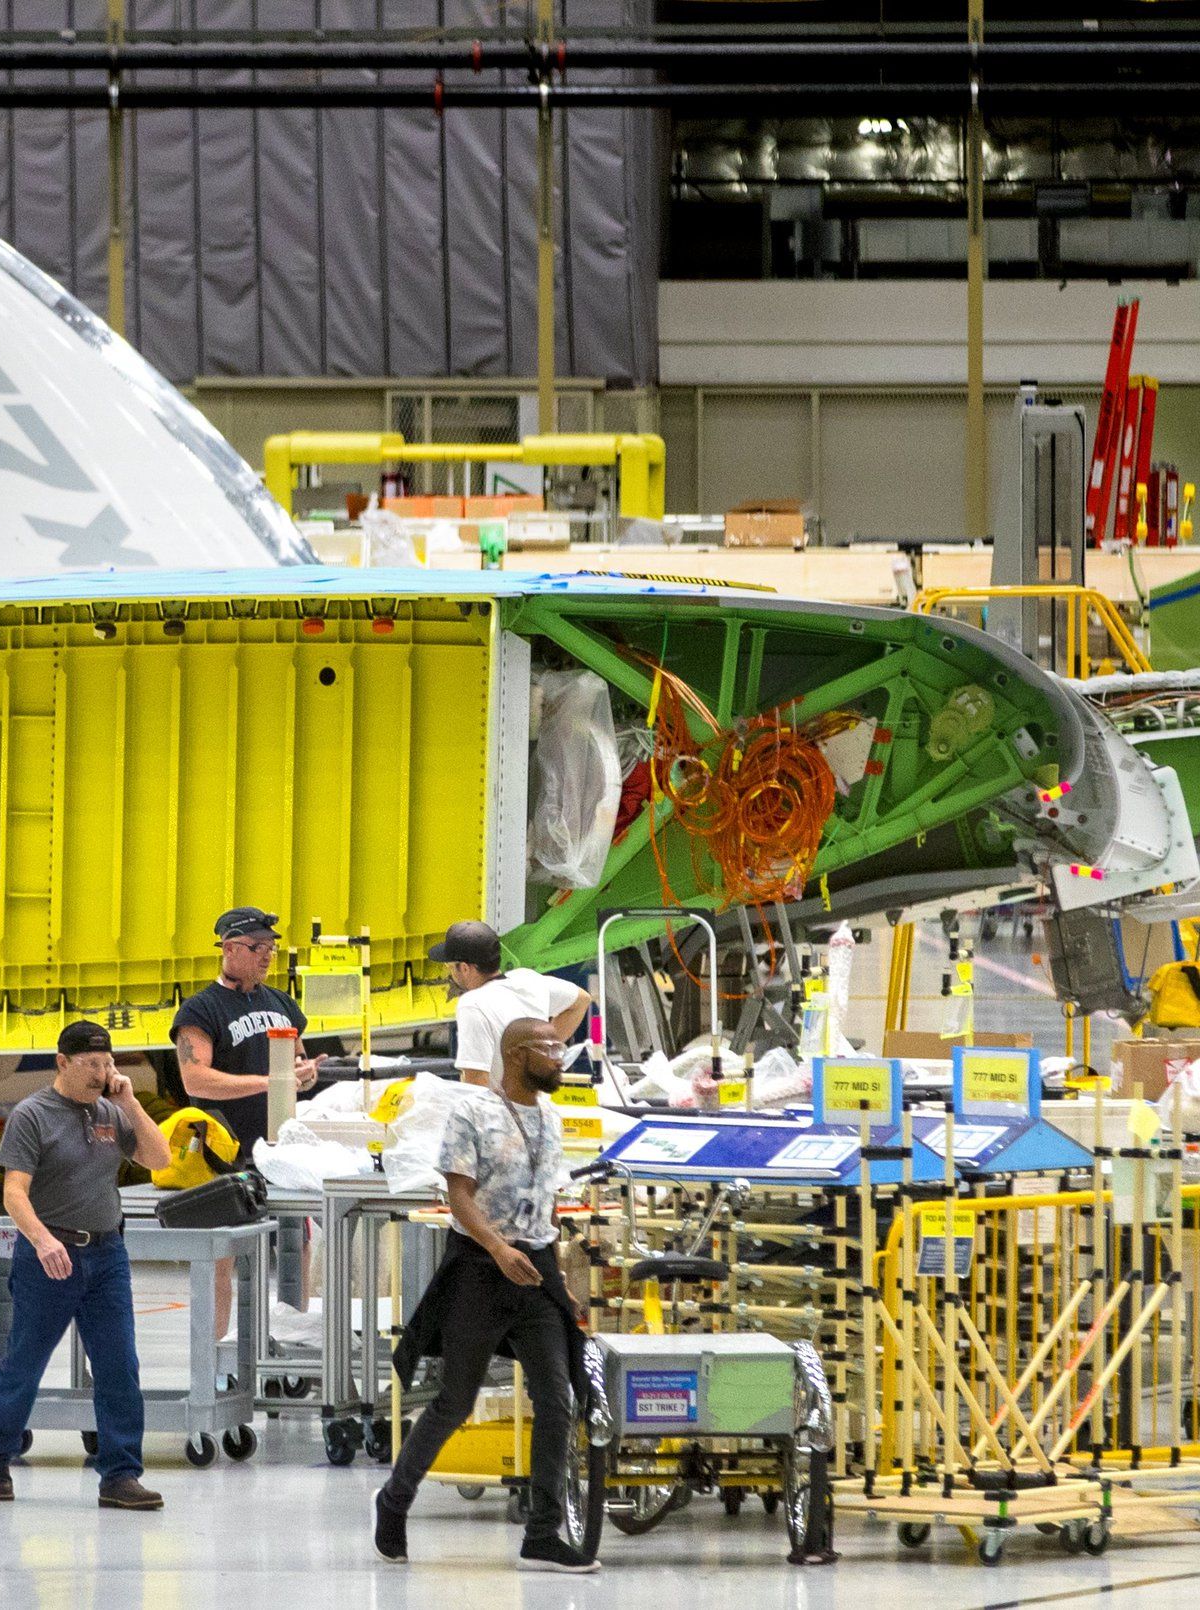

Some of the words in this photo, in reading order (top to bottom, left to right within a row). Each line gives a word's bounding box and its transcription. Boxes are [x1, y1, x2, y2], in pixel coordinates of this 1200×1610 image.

[331, 954, 346, 962] Work
[973, 1071, 988, 1081] 777
[990, 1072, 1007, 1082] MID
[833, 1080, 849, 1091] 777
[852, 1081, 869, 1091] MID
[571, 1094, 586, 1103] Work
[573, 1119, 594, 1128] 5548
[639, 1403, 653, 1412] SST
[655, 1403, 678, 1412] TRIKE
